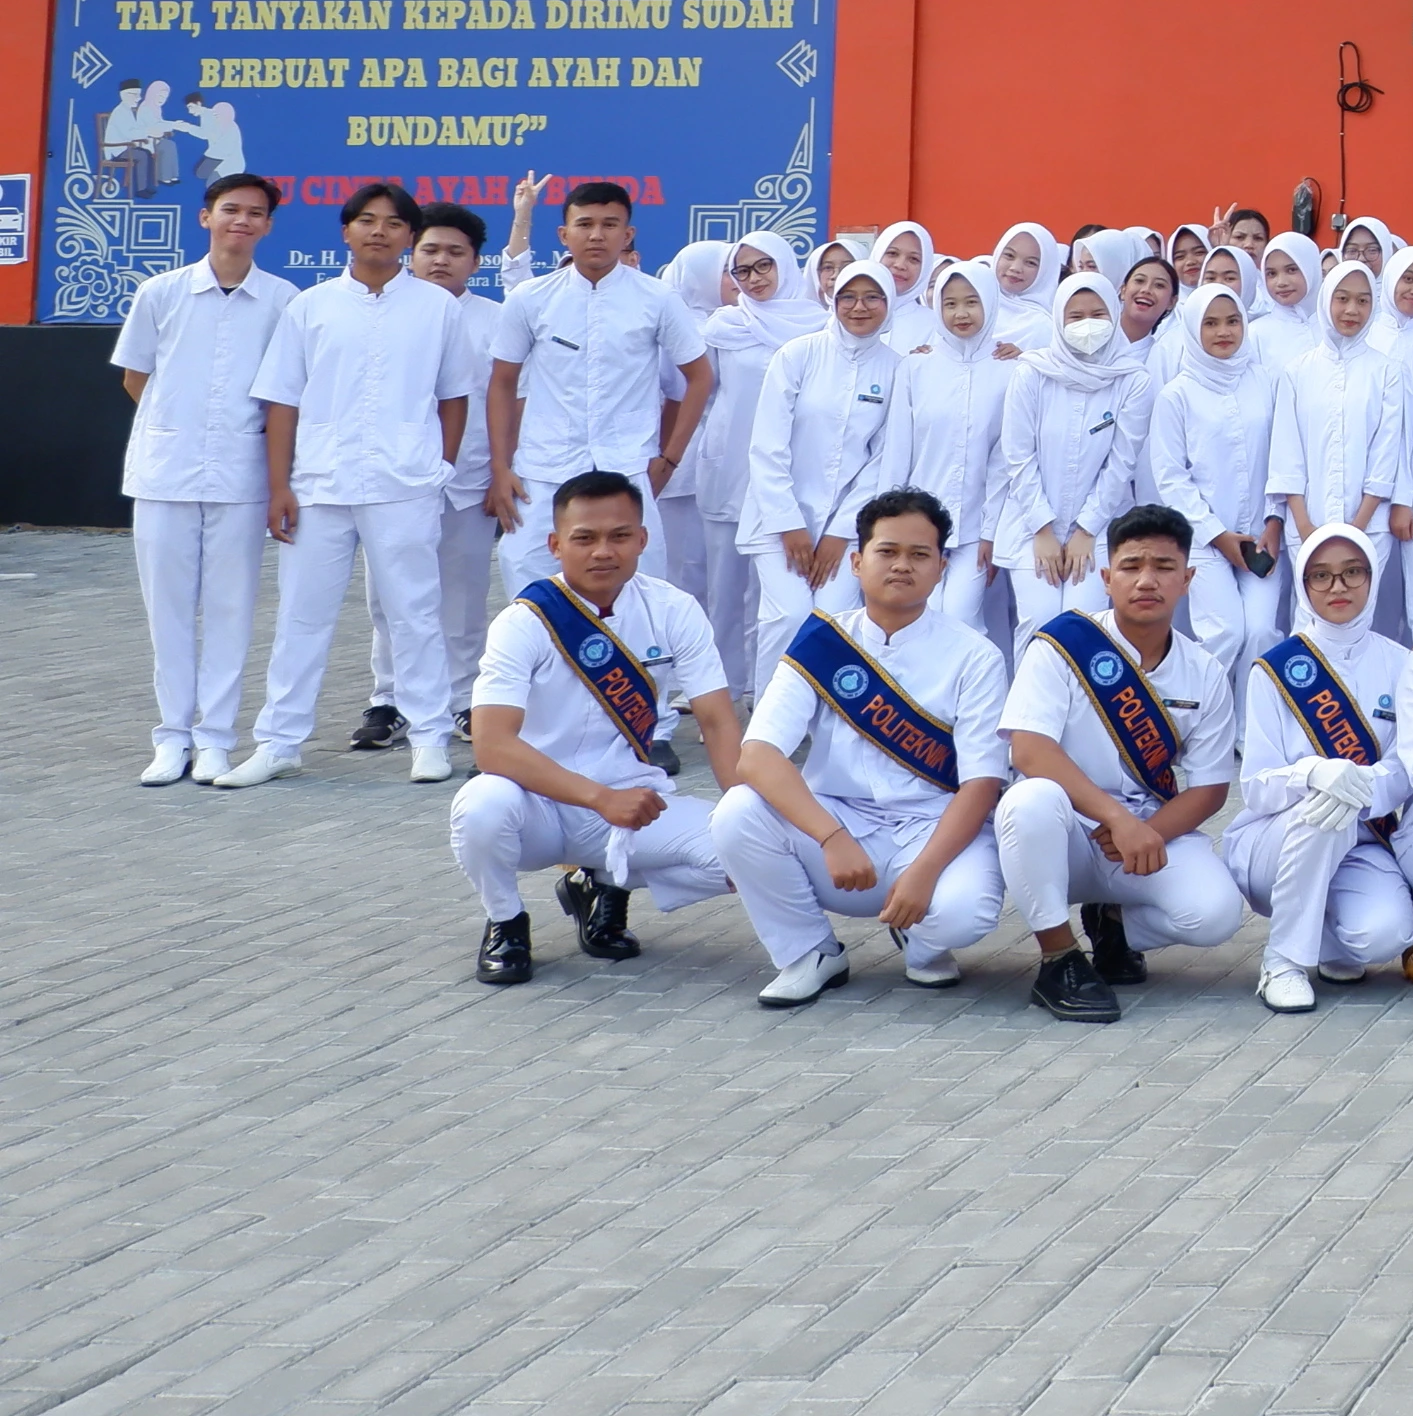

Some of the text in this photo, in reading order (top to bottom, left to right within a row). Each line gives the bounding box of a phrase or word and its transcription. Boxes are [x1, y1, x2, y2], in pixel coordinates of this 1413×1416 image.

[116, 0, 793, 36] TAPI, TANYAKAN KEPADA DIRIMU SUDAH
[200, 57, 701, 88] BERBUAT APA BAGI AYAH DAN
[347, 114, 547, 146] BUNDAMU?”
[415, 175, 509, 206] AYAH
[289, 249, 341, 266] Dr. H.
[860, 694, 953, 773] POLITEKNIK
